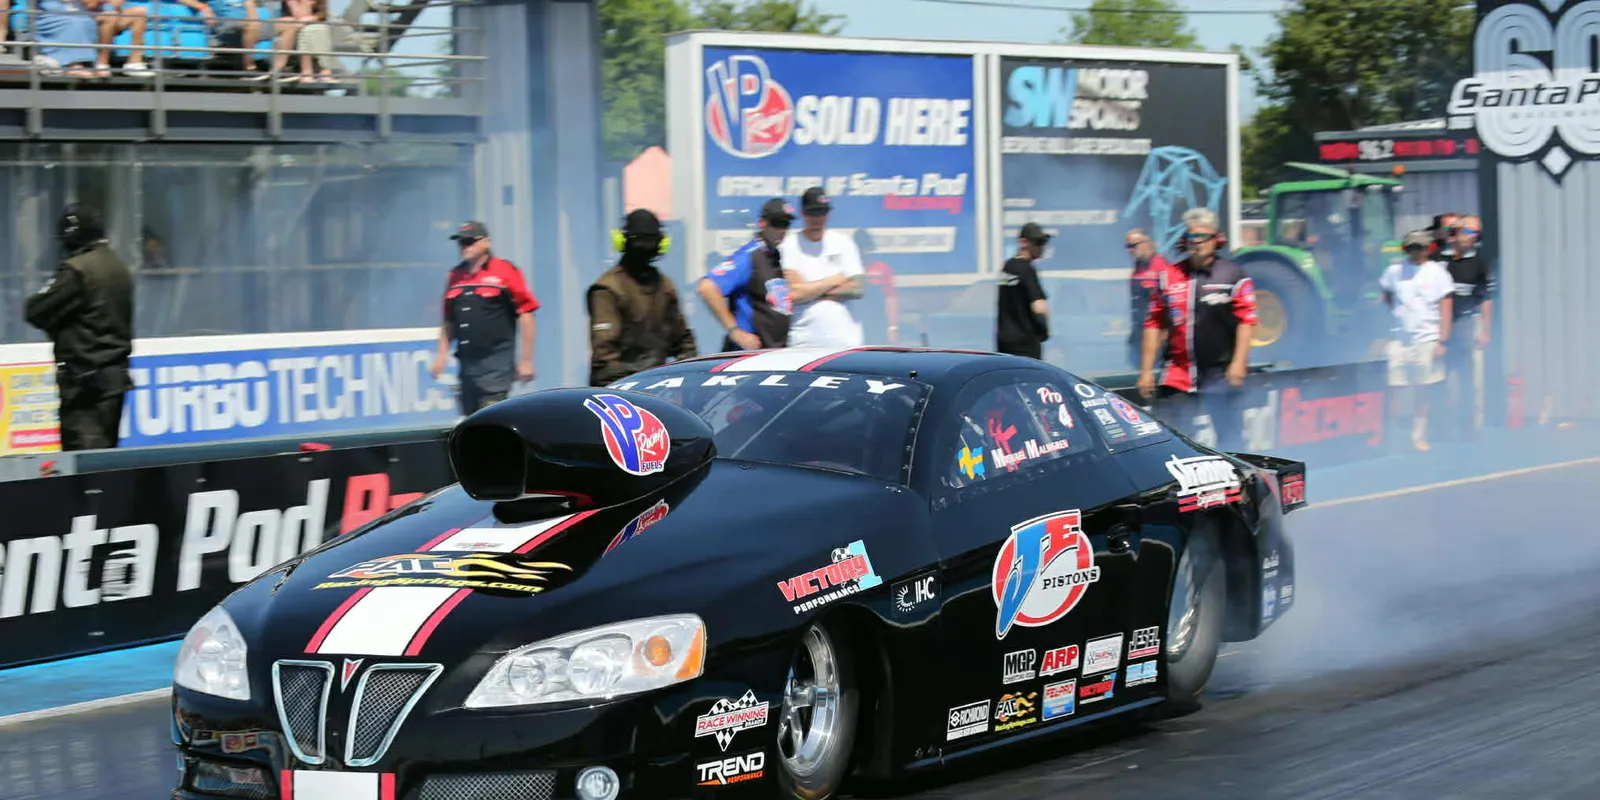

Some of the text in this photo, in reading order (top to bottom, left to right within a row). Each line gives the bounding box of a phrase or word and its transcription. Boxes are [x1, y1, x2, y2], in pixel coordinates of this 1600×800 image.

[1456, 82, 1570, 108] Santa
[793, 95, 882, 145] SOLD
[884, 98, 971, 146] HERE
[1036, 386, 1063, 405] Pro
[583, 394, 645, 473] VP
[642, 461, 663, 471] FUELS
[0, 514, 159, 619] nta
[177, 478, 331, 592] Pod
[777, 554, 870, 603] VICTORY
[1041, 568, 1099, 591] PISTONS
[792, 583, 862, 615] PERFORMANCE
[1005, 649, 1035, 677] MGP
[1041, 646, 1078, 672] ARP
[697, 707, 766, 731] RACE WINNING
[696, 751, 765, 785] TREND
